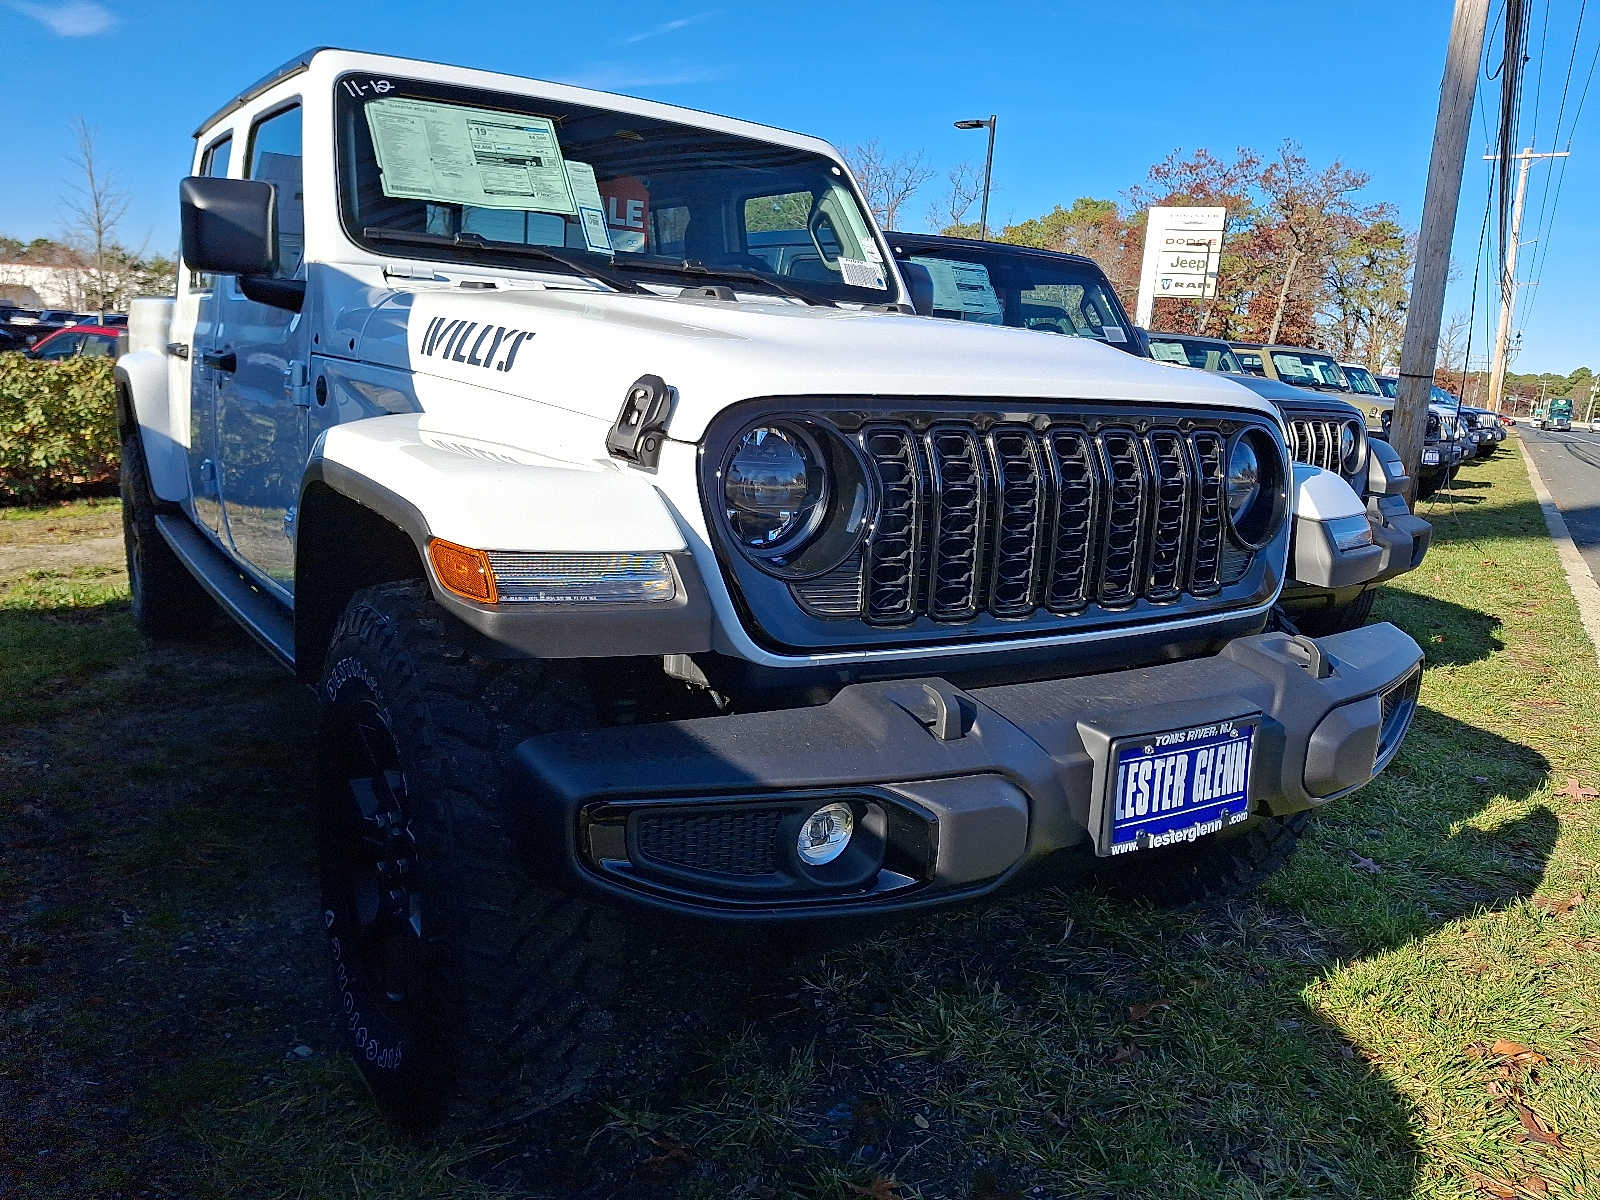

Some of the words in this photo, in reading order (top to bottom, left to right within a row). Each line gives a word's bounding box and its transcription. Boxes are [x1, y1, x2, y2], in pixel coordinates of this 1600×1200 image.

[601, 195, 645, 229] LE
[1165, 238, 1217, 247] DODGE
[1170, 255, 1207, 271] Jeep
[1174, 281, 1211, 289] RAM
[420, 316, 536, 373] WILLYS
[1156, 731, 1185, 747] TOMS
[1219, 722, 1233, 735] NJ
[1115, 754, 1189, 821] LESTER
[1192, 740, 1248, 803] GLENN
